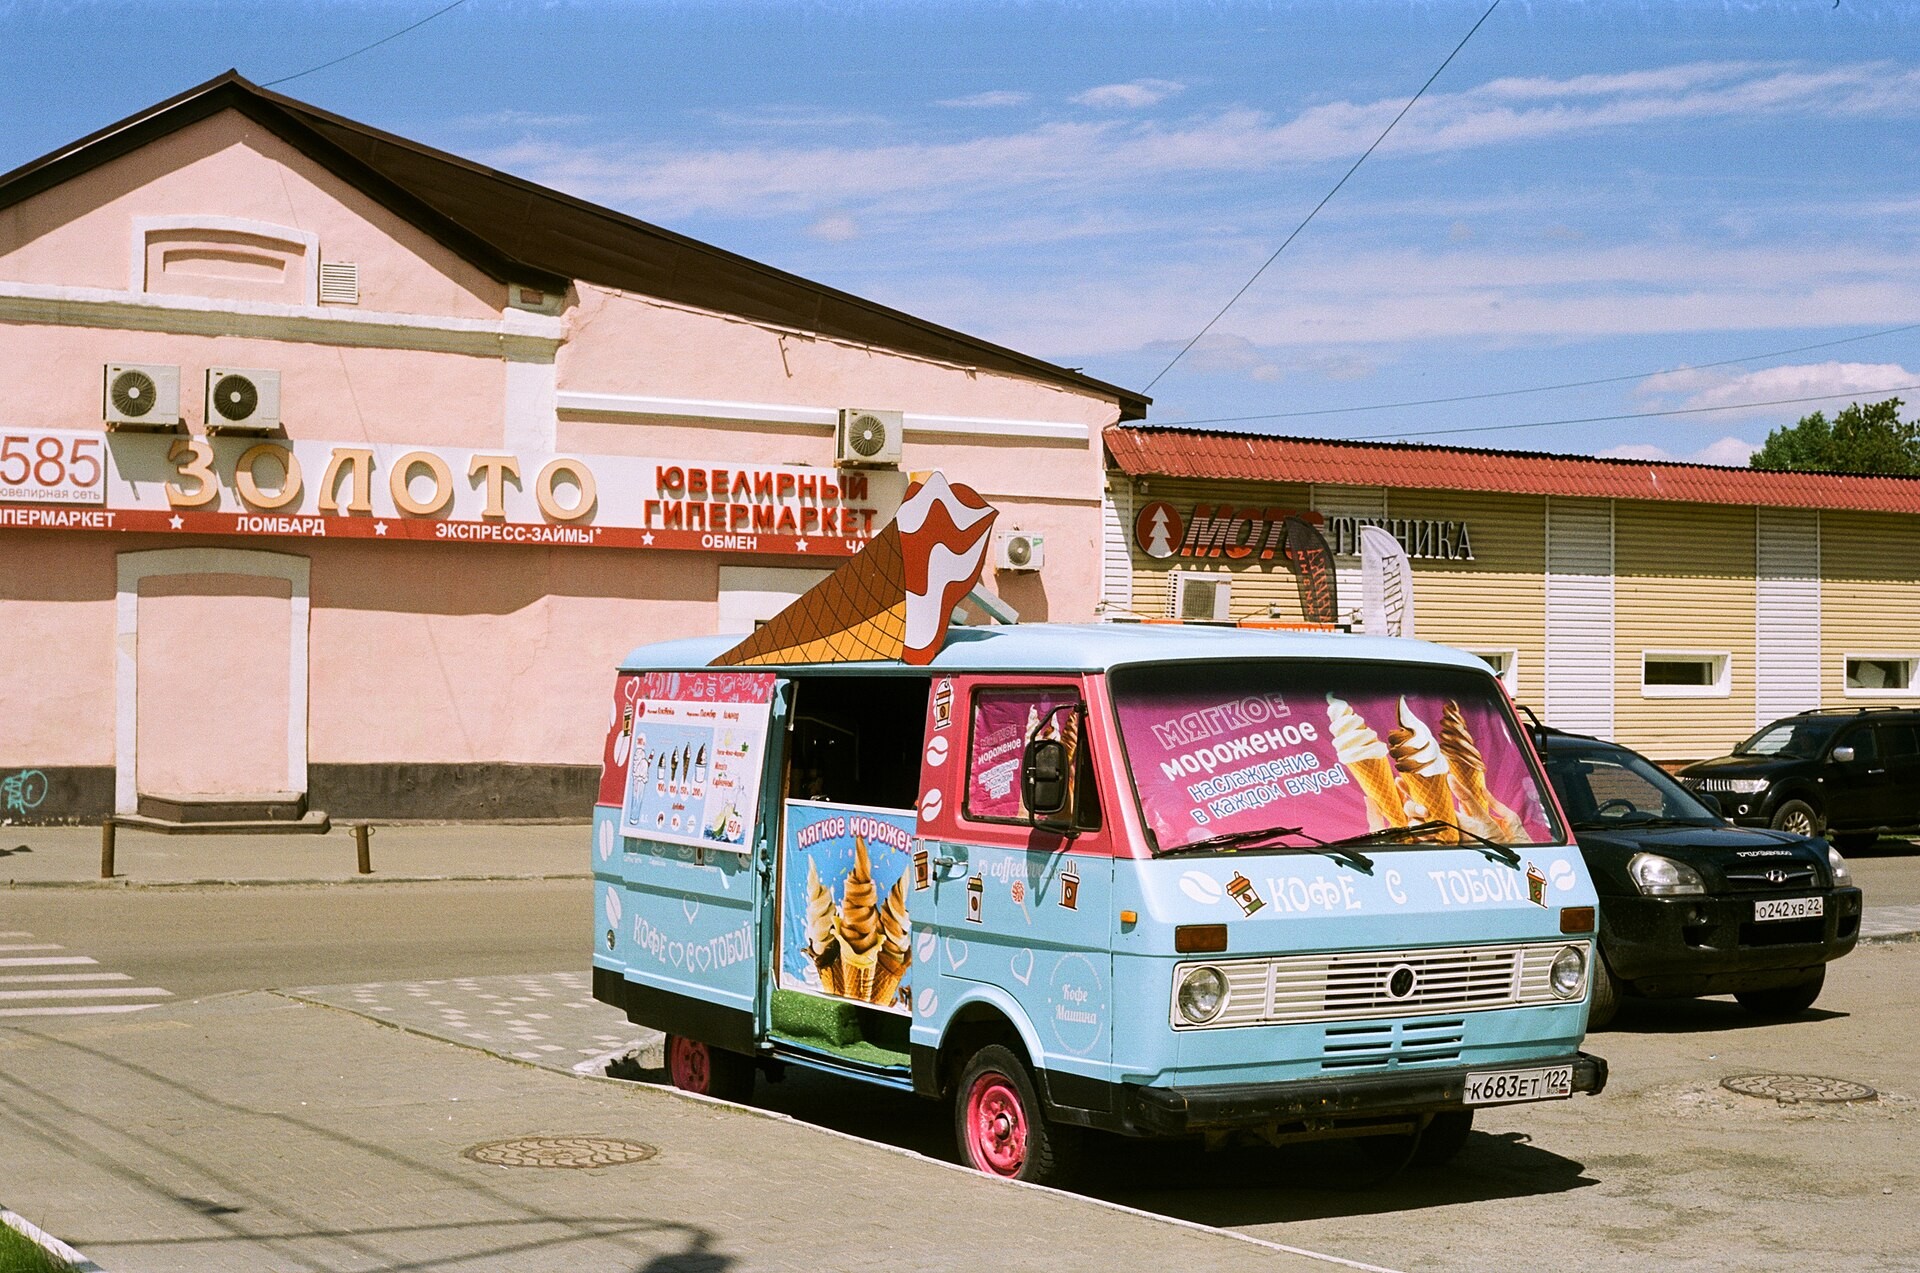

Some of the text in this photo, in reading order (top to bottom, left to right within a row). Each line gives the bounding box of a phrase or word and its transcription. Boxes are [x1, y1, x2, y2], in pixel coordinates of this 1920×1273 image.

[0, 436, 100, 487] 585
[165, 439, 597, 520] ЗОЛОТО
[656, 465, 868, 500] ЮВЕЛИРНЫЙ
[73, 489, 101, 500] сеть
[644, 499, 877, 532] ГИПЕРМАРКЕТ
[236, 516, 326, 536] ЛОМБАРД
[435, 523, 594, 543] ЭКСПРЕСС-ЗАЙМЫ
[701, 534, 757, 551] ОБМЕН
[1329, 516, 1475, 560] ТЕНИКА
[1150, 692, 1291, 751] МЯГКОЕ
[1159, 721, 1319, 782] мороженое
[1188, 751, 1319, 802] наслаждение
[1192, 764, 1349, 824] в каждом вкусе!
[1266, 864, 1523, 913] КОФЕ С ТОБОЙ
[1759, 899, 1820, 919] О242ХВ 22
[633, 914, 668, 963] КОФЕ
[709, 920, 754, 970] ТОБОЙ
[1055, 1004, 1097, 1025] Машина
[1062, 983, 1088, 1006] Кофе
[1471, 1070, 1568, 1100] К683ЕТ 122
